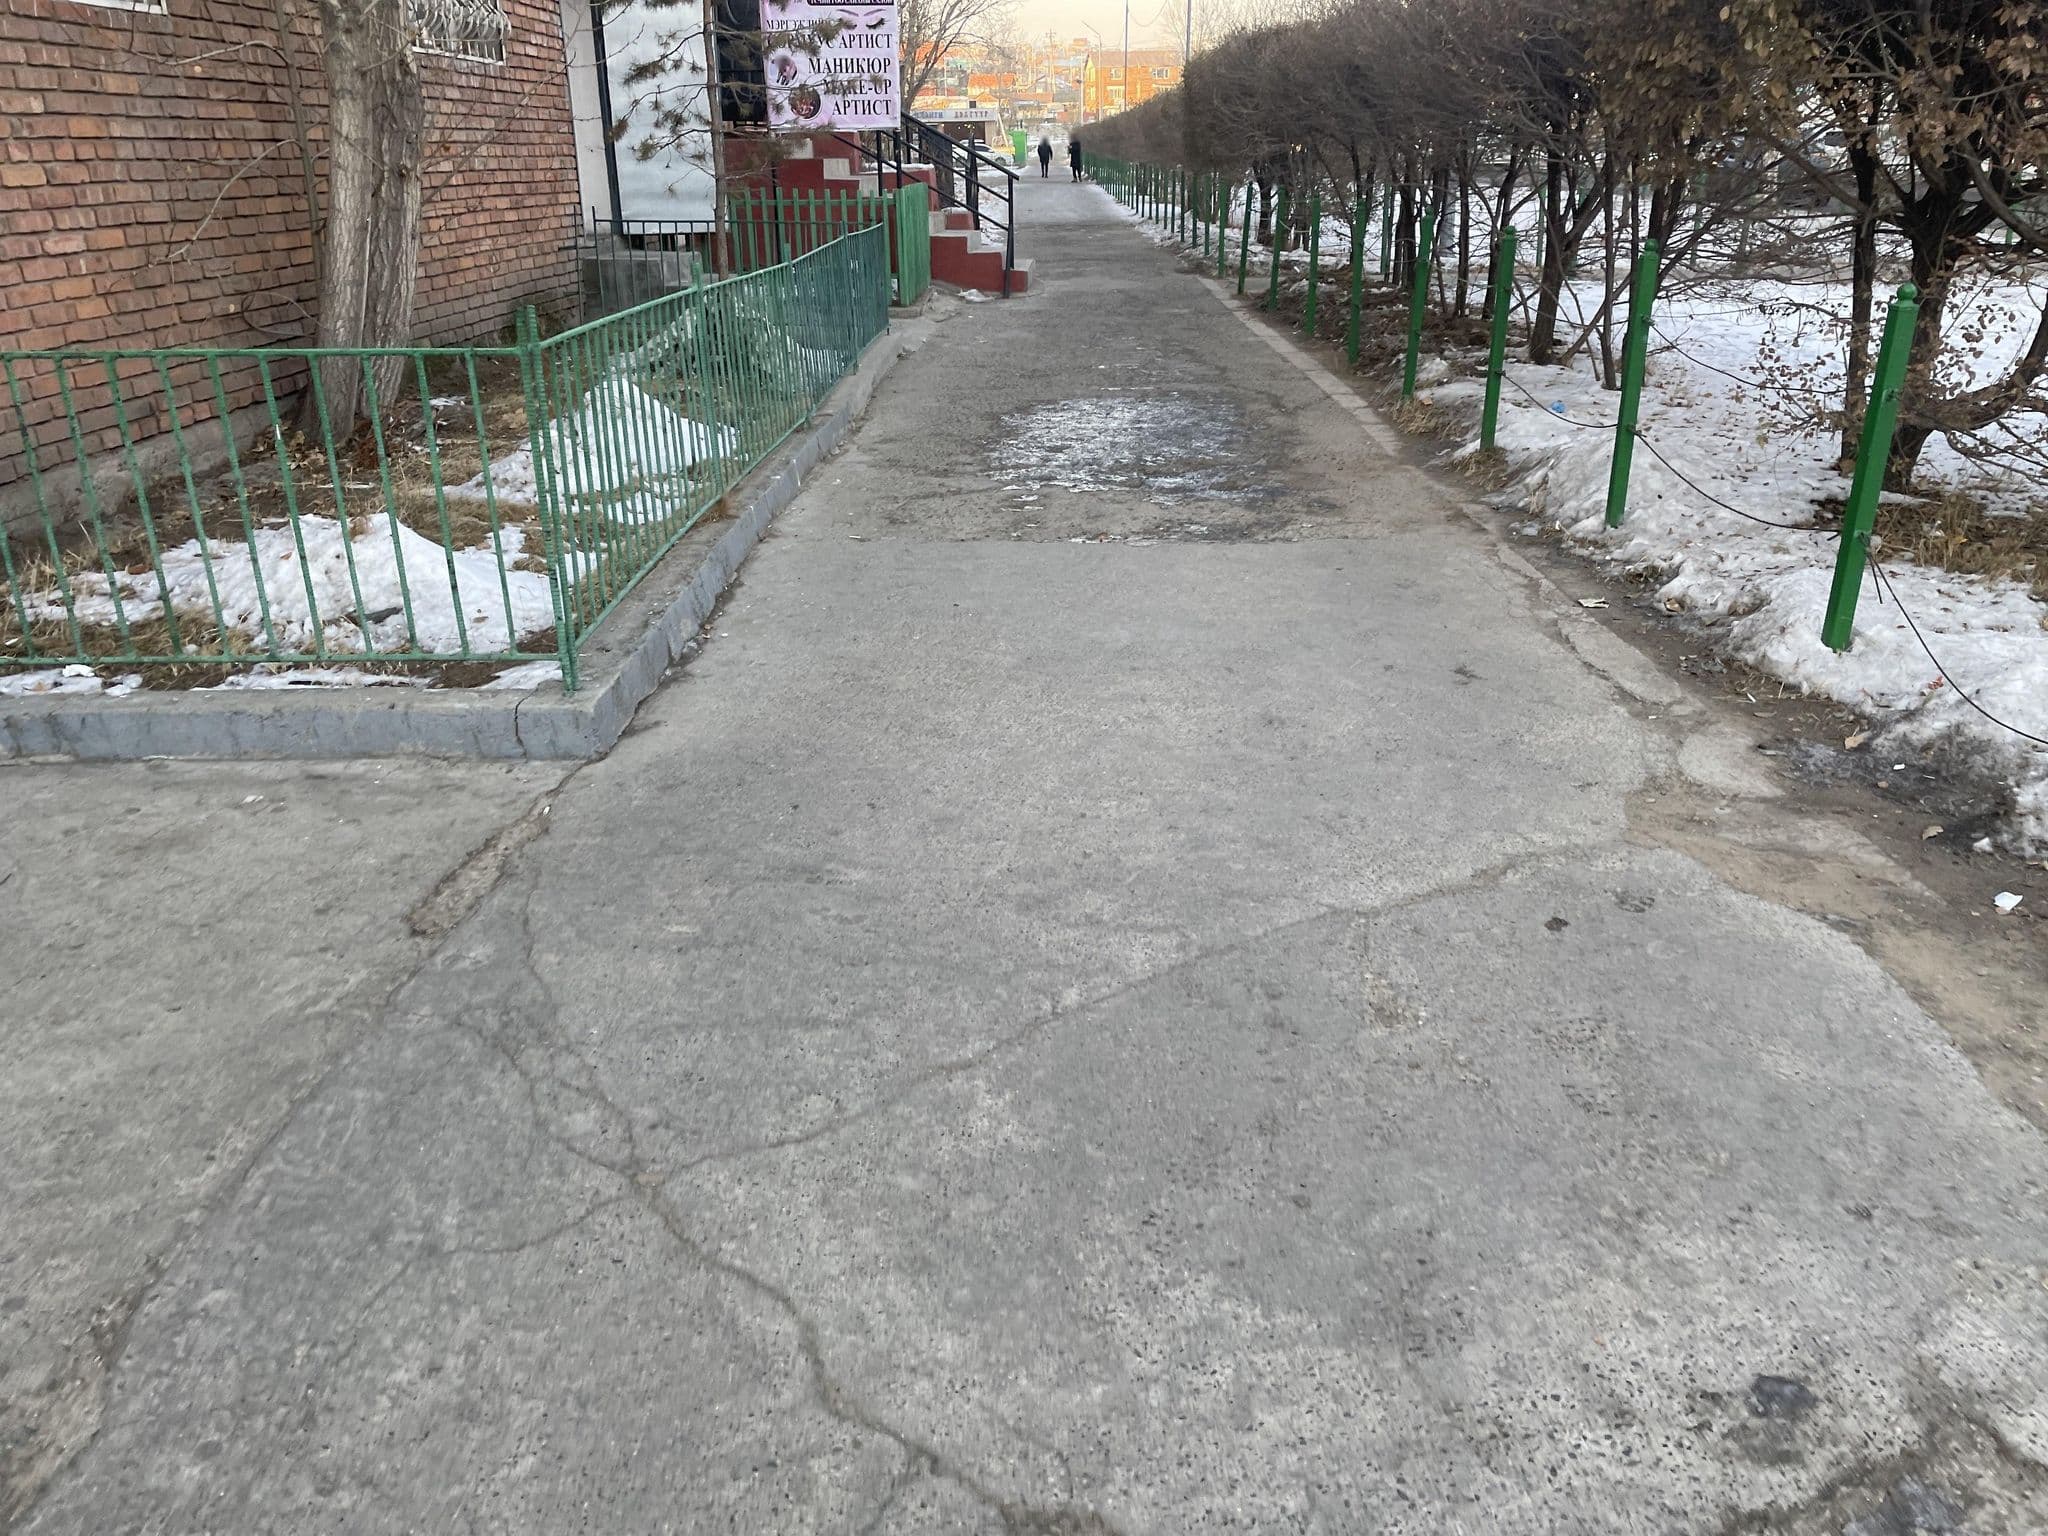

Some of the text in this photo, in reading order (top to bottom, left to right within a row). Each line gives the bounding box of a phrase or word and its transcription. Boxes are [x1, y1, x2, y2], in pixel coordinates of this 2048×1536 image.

[839, 33, 893, 49] АРТИСТ
[808, 57, 891, 74] МАНИКЮР
[832, 99, 892, 116] АРТИСТ
